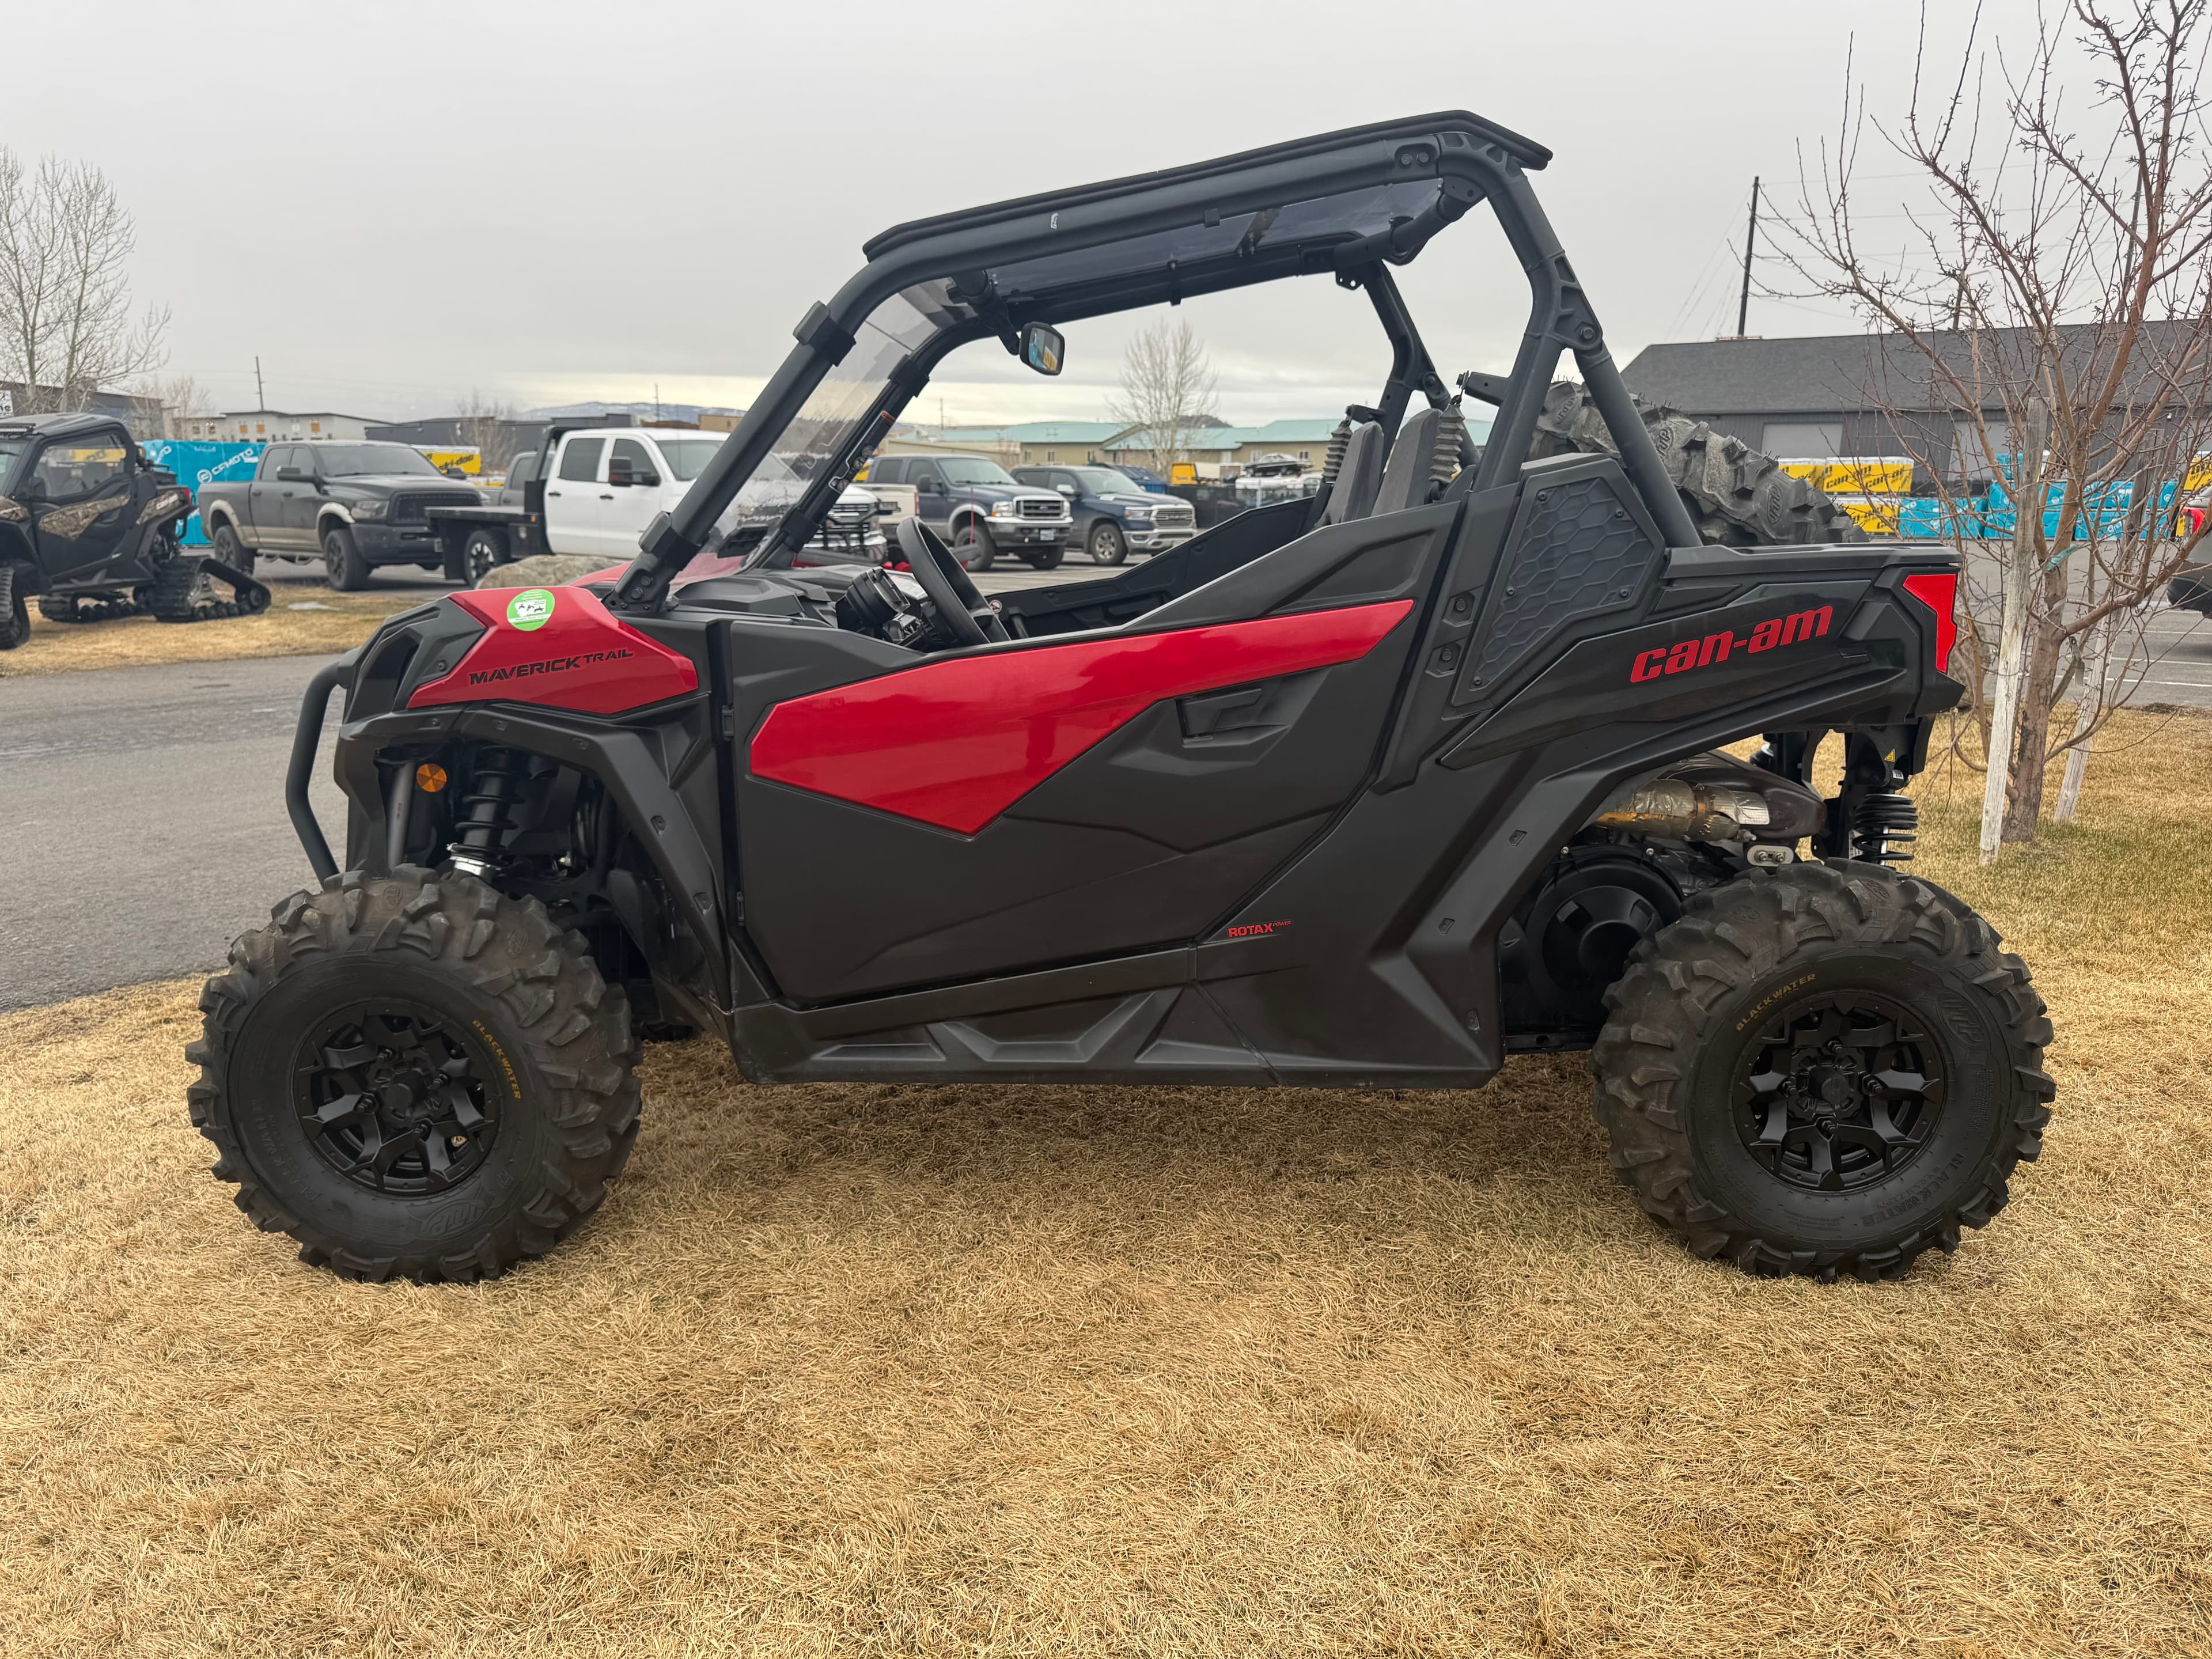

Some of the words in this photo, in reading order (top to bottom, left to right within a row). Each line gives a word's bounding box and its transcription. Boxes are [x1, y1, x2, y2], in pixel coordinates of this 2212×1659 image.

[211, 448, 254, 475] CFMOTO
[469, 656, 582, 685] MAVERICK
[583, 649, 634, 664] TRAIL
[1630, 605, 1833, 683] can-am
[1228, 923, 1274, 938] ROTAX
[1736, 973, 1816, 1031] BLACKWATER
[472, 1020, 521, 1099] BLACKWATER
